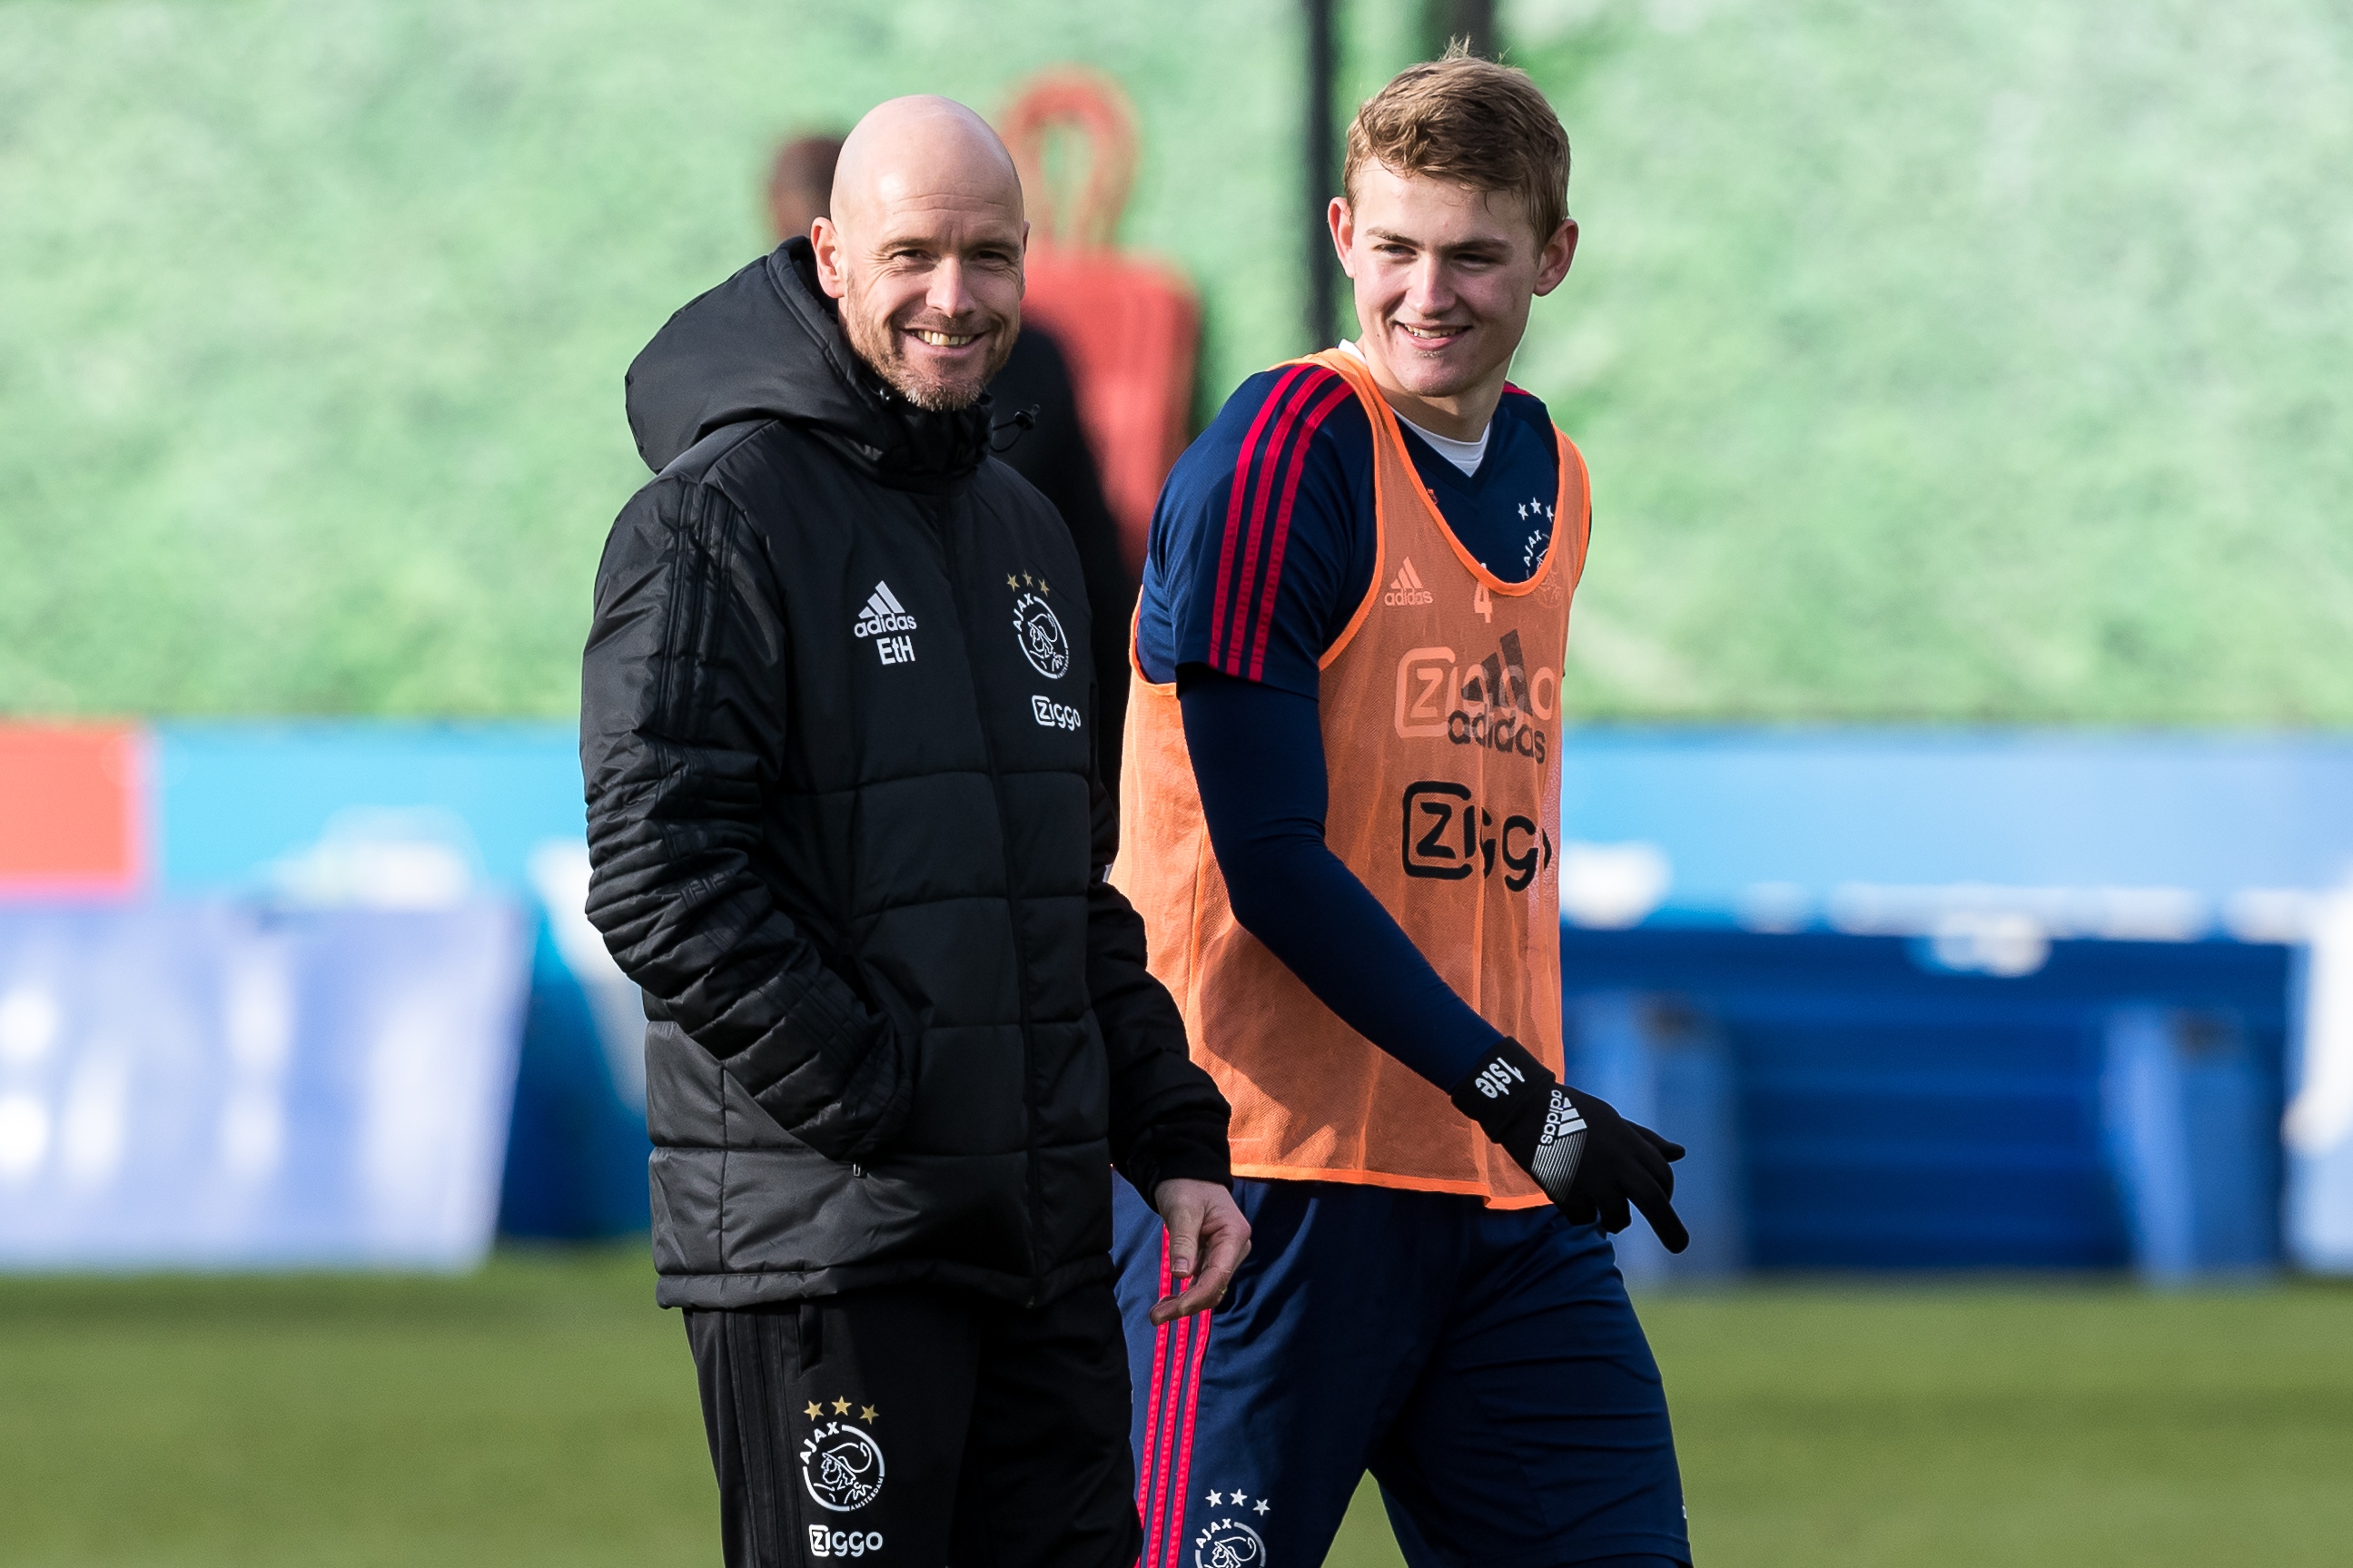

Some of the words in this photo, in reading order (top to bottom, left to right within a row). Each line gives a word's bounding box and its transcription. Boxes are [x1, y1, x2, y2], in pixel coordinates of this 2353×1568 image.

[1524, 529, 1542, 567] AJAX
[1013, 593, 1033, 632] AJAX
[1384, 588, 1433, 606] adidas
[854, 614, 917, 637] adidas
[876, 636, 915, 665] EtH
[1032, 695, 1082, 731] Ziggo
[1448, 709, 1546, 764] adidas
[1475, 1058, 1525, 1099] 1ste
[1540, 1090, 1562, 1144] adidas
[800, 1422, 839, 1464] AJAX
[850, 1477, 884, 1511] AMSTERDAM
[809, 1524, 883, 1557] Ziggo
[1195, 1518, 1232, 1549] AJAX
